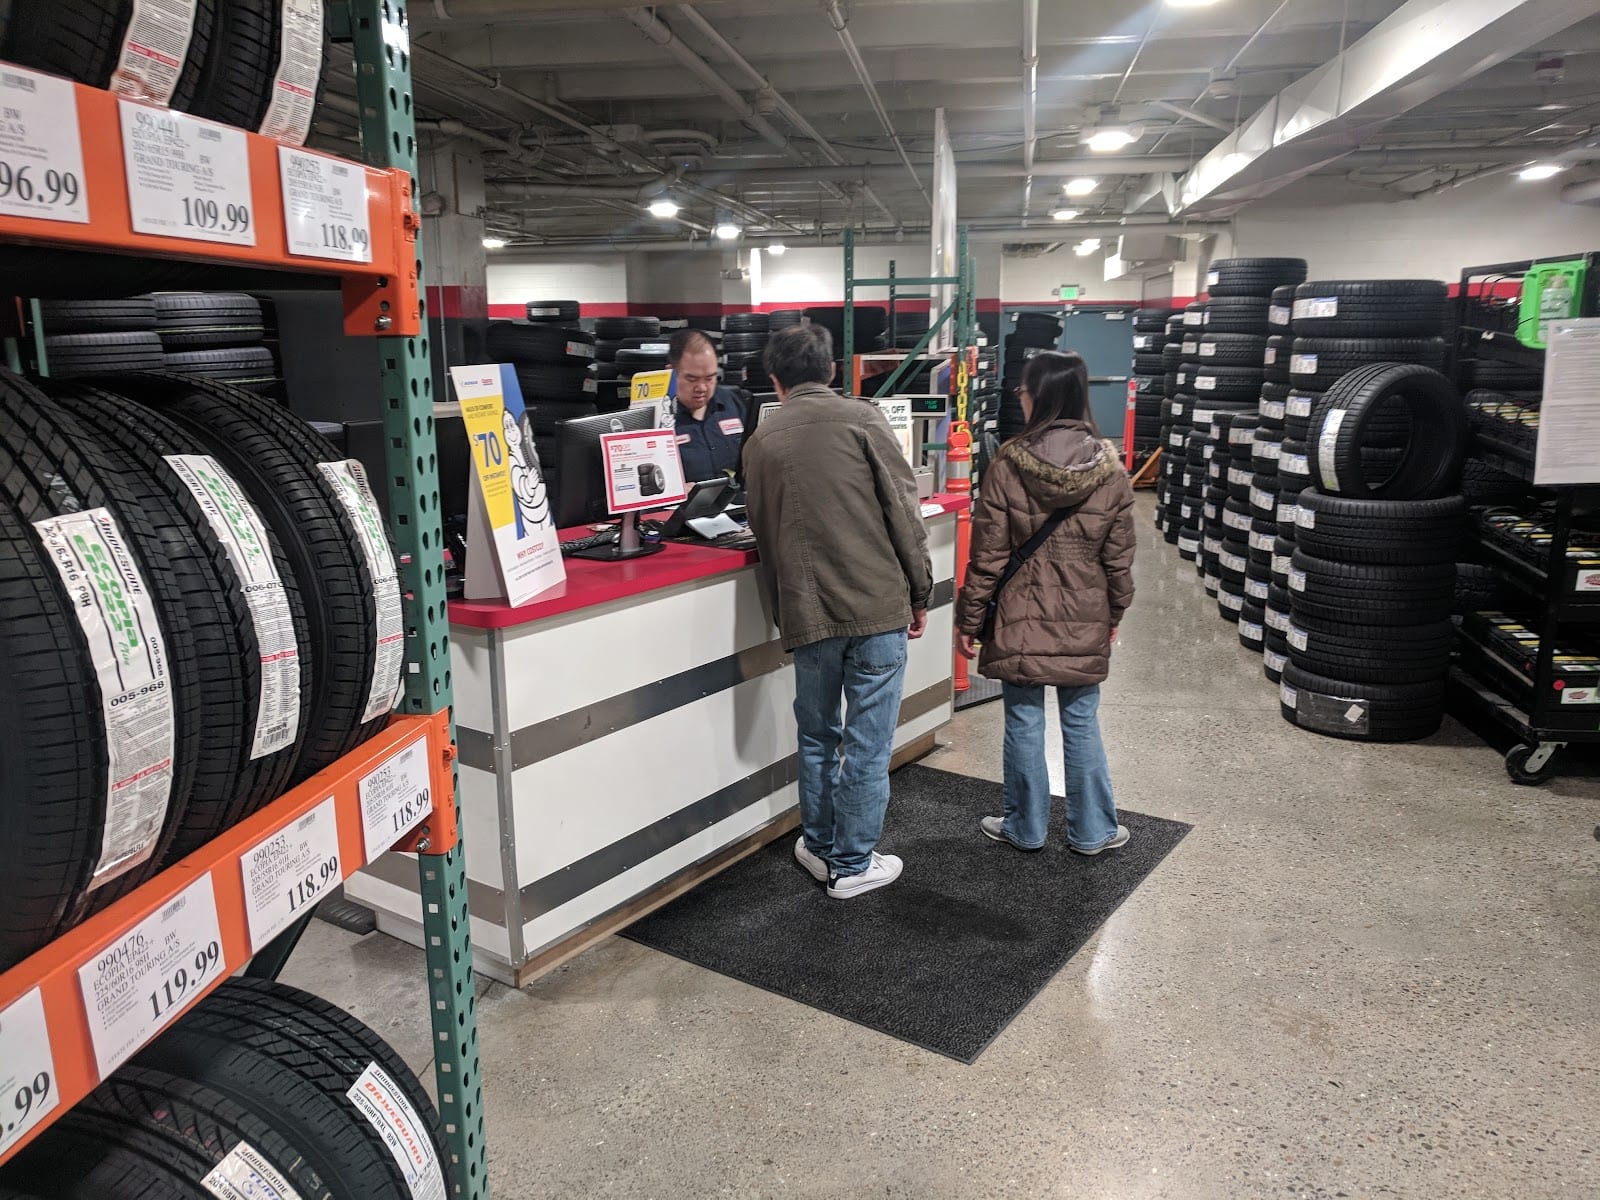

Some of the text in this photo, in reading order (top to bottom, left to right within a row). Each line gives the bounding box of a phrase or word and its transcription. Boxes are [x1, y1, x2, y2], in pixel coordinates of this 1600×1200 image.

[0, 161, 79, 207] 96.99
[181, 197, 249, 233] 109.99
[891, 405, 905, 413] OFF
[473, 431, 502, 467] $70
[97, 515, 143, 596] BRIDGESTONE
[150, 635, 164, 677] 005-968
[110, 679, 166, 708] 005-968
[391, 787, 429, 834] 118.99
[250, 857, 272, 878] ECOPIA
[252, 847, 311, 896] GRAND TOURING A/S
[253, 834, 286, 867] 990253
[287, 855, 338, 914] 118.99
[97, 929, 145, 975] 990476
[164, 929, 177, 946] BW
[93, 961, 125, 991] ECOPIA
[95, 951, 150, 1002] 225/60R16 98H
[97, 981, 128, 1012] GRAND
[129, 951, 166, 985] TOURING
[167, 939, 181, 954] A/S
[149, 940, 219, 1022] 119.99
[0, 1071, 50, 1139] .99
[374, 1068, 409, 1112] BRIDGESTONE
[364, 1081, 423, 1165] DRIVEGUARD
[241, 1146, 289, 1195] BRIDGESTONE
